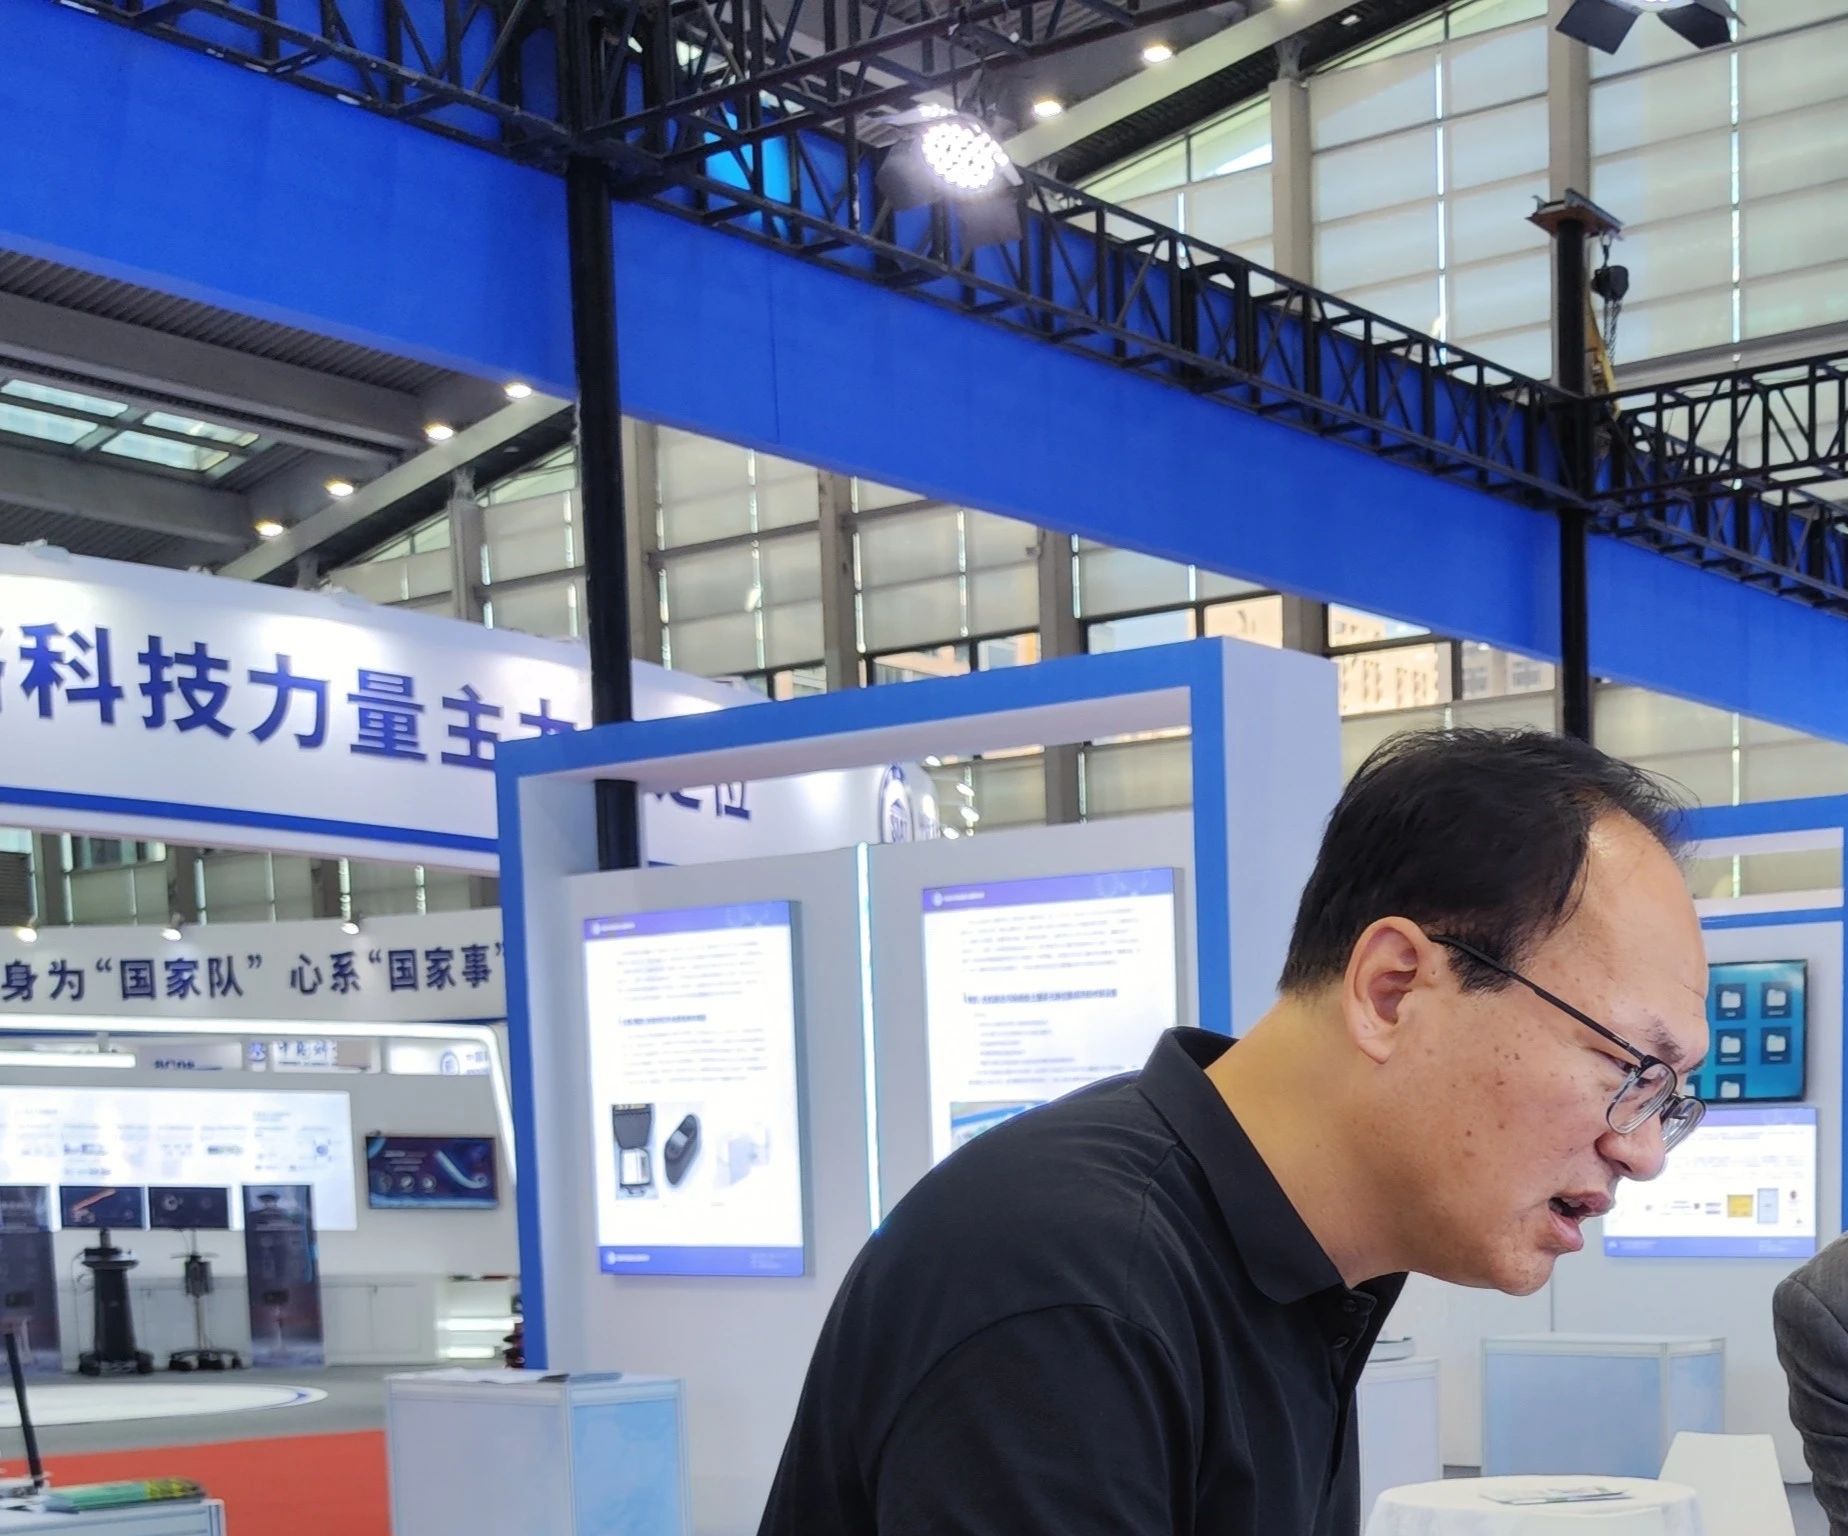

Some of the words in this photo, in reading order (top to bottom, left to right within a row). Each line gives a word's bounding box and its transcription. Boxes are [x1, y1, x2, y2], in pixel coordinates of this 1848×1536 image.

[0, 622, 577, 770] 科技力量主
[1, 953, 262, 1001] 身为“国家队”
